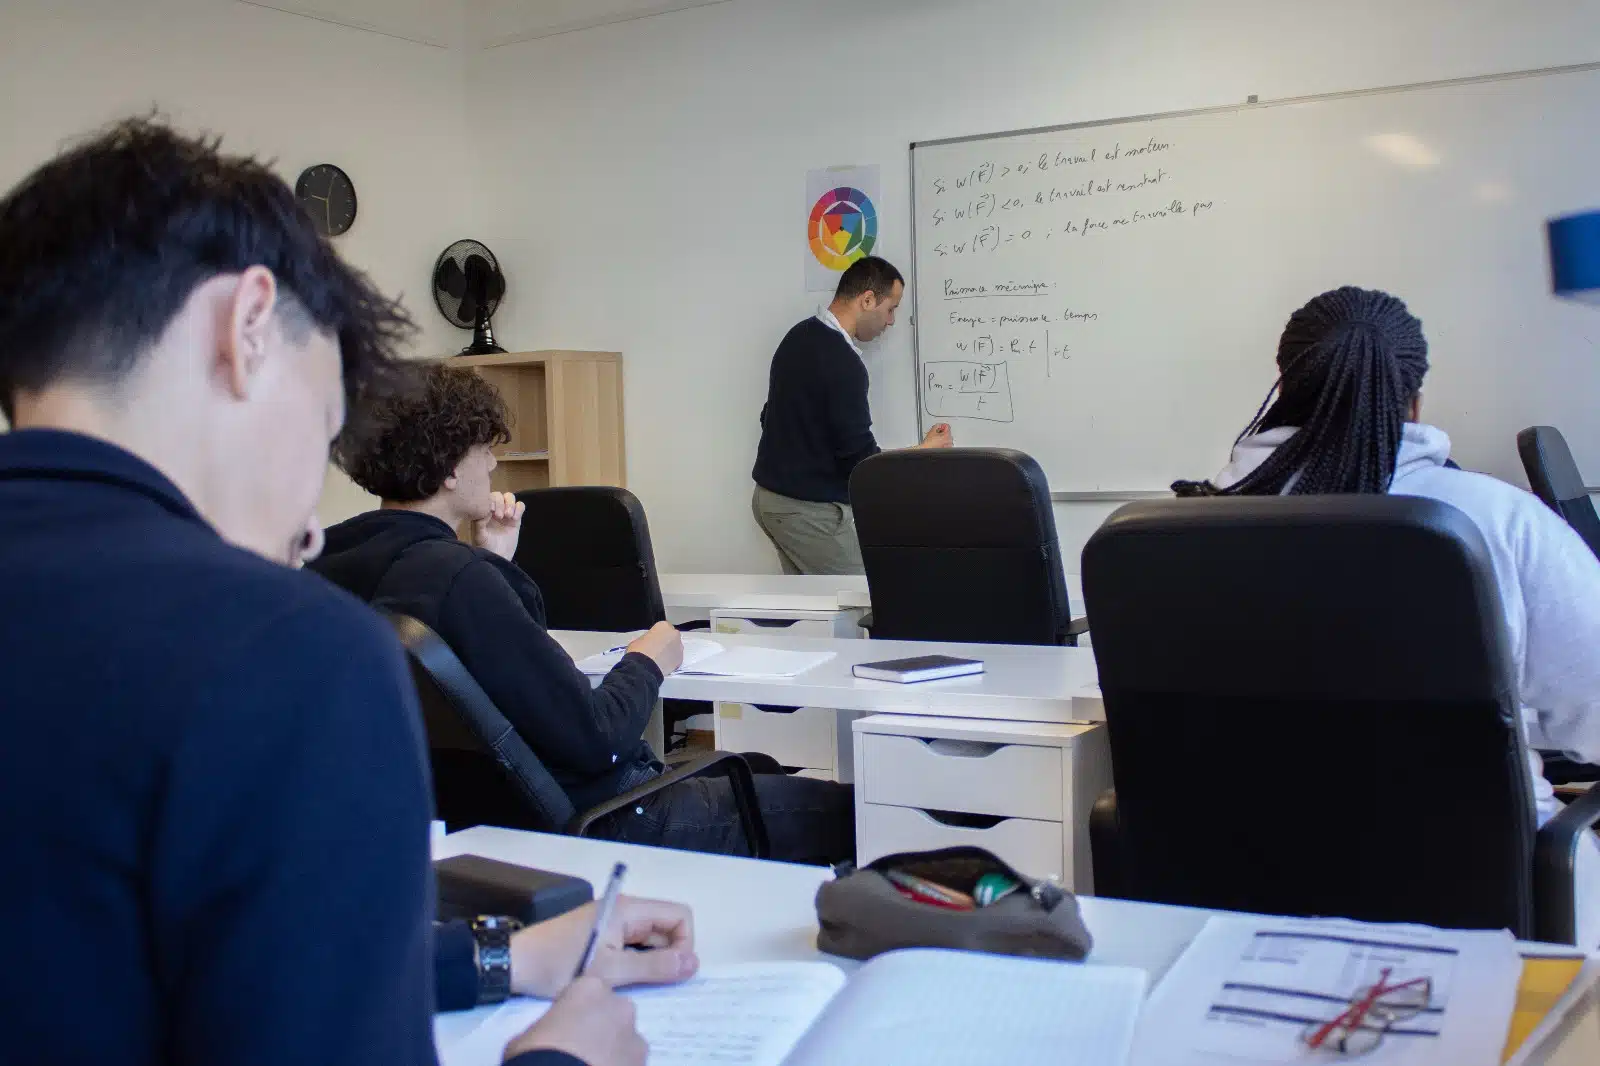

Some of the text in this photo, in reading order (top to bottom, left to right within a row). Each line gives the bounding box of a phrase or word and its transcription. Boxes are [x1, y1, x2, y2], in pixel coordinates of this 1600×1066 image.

[1055, 149, 1096, 167] travail
[1105, 142, 1120, 160] est
[1049, 180, 1093, 202] travail
[1097, 178, 1112, 193] est
